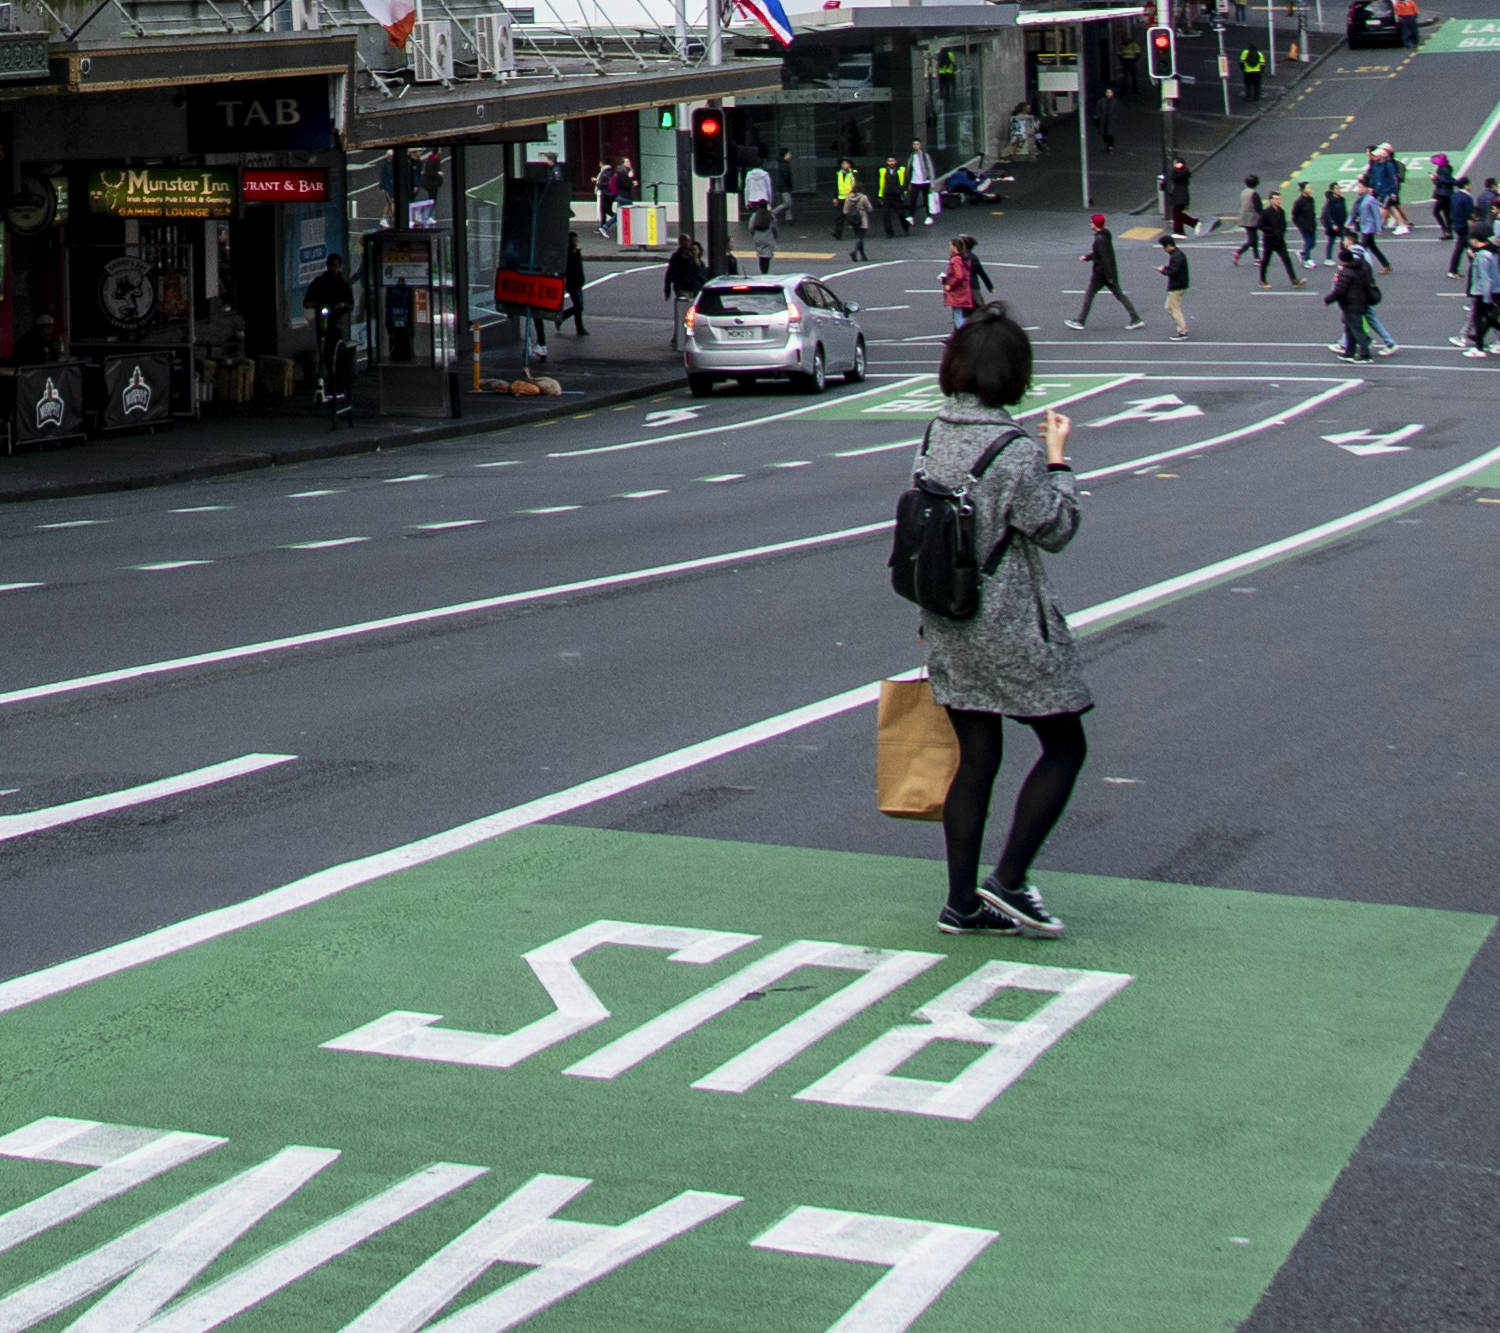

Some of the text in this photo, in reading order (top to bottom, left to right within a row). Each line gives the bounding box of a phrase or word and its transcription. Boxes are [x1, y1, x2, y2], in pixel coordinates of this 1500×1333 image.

[217, 97, 300, 127] TAB
[127, 170, 230, 196] Munster Inn
[283, 180, 296, 191] &
[299, 180, 325, 192] BAR
[126, 195, 142, 203] Irish
[143, 195, 164, 205] Sports
[165, 195, 177, 203] Pub
[205, 195, 232, 205] Gaming
[118, 208, 162, 217] GAMING
[165, 208, 210, 217] LOUNGE
[860, 399, 946, 413] BU
[317, 919, 1136, 1121] BUS
